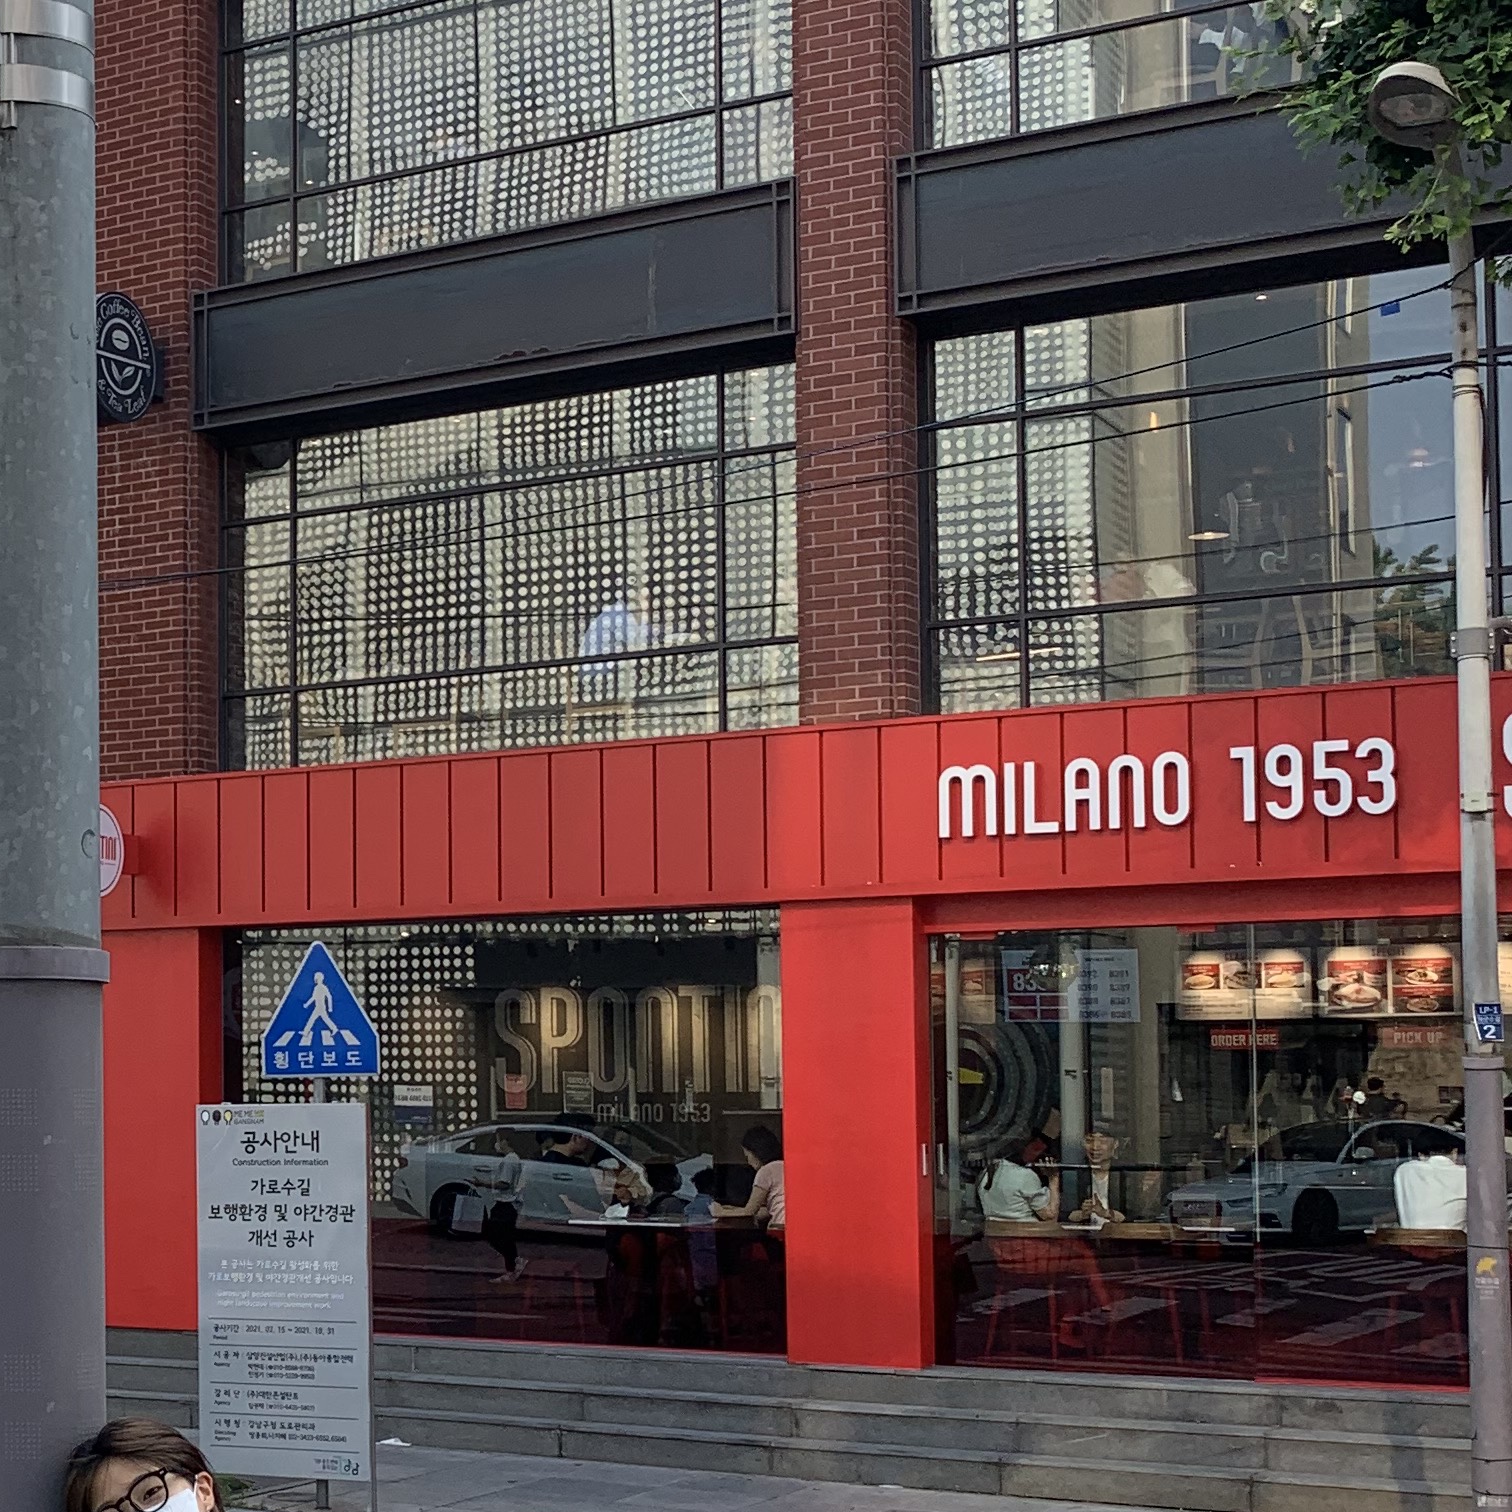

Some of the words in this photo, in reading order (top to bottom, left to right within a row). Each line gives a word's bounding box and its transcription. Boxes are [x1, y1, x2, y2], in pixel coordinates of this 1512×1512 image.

[100, 298, 130, 320] Coffee
[131, 309, 150, 359] Bean
[107, 388, 123, 413] Tea
[124, 385, 147, 414] Leaf
[938, 751, 1190, 839] MILANO
[1229, 737, 1396, 823] 1953
[1479, 1006, 1498, 1014] LP-1
[1394, 1031, 1421, 1044] PICK
[1427, 1031, 1443, 1043] UP
[1483, 1025, 1496, 1039] 2
[1211, 1034, 1247, 1047] ORDER
[240, 1130, 320, 1154] 공사안내
[232, 1157, 281, 1166] Construction
[283, 1157, 329, 1166] Information
[250, 1178, 310, 1196] 가로수길
[208, 1204, 268, 1222] 보행환경
[273, 1204, 287, 1222] 및
[294, 1204, 355, 1222] 야간경관
[248, 1230, 277, 1247] 개선
[283, 1230, 314, 1248] 공사
[256, 1259, 287, 1270] 가로수길
[213, 1323, 240, 1333] 공사기간
